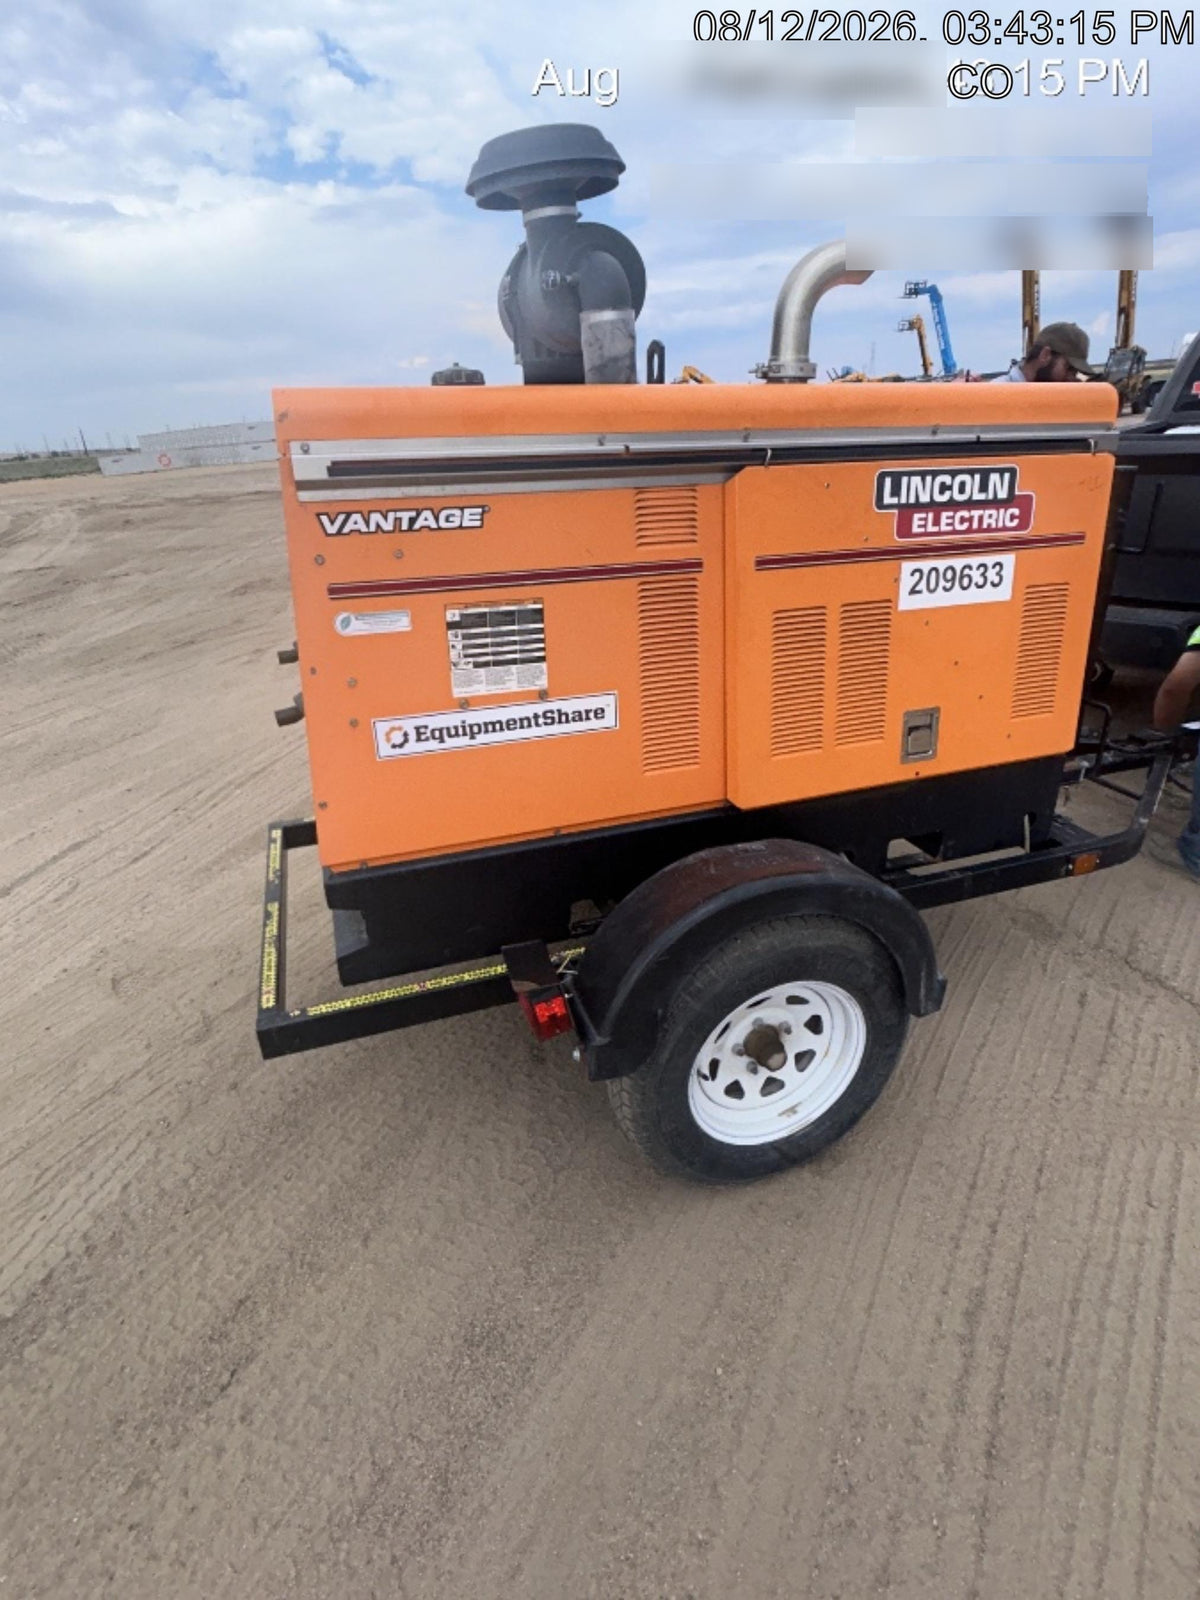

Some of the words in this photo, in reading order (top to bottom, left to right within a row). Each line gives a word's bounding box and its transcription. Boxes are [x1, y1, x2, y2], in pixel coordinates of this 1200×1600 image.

[882, 471, 1011, 505] LINCOLN
[316, 506, 484, 537] VANTAGE
[911, 507, 1021, 534] ELECTRIC
[908, 561, 1004, 596] 209633
[414, 705, 606, 741] EquipmentShare
